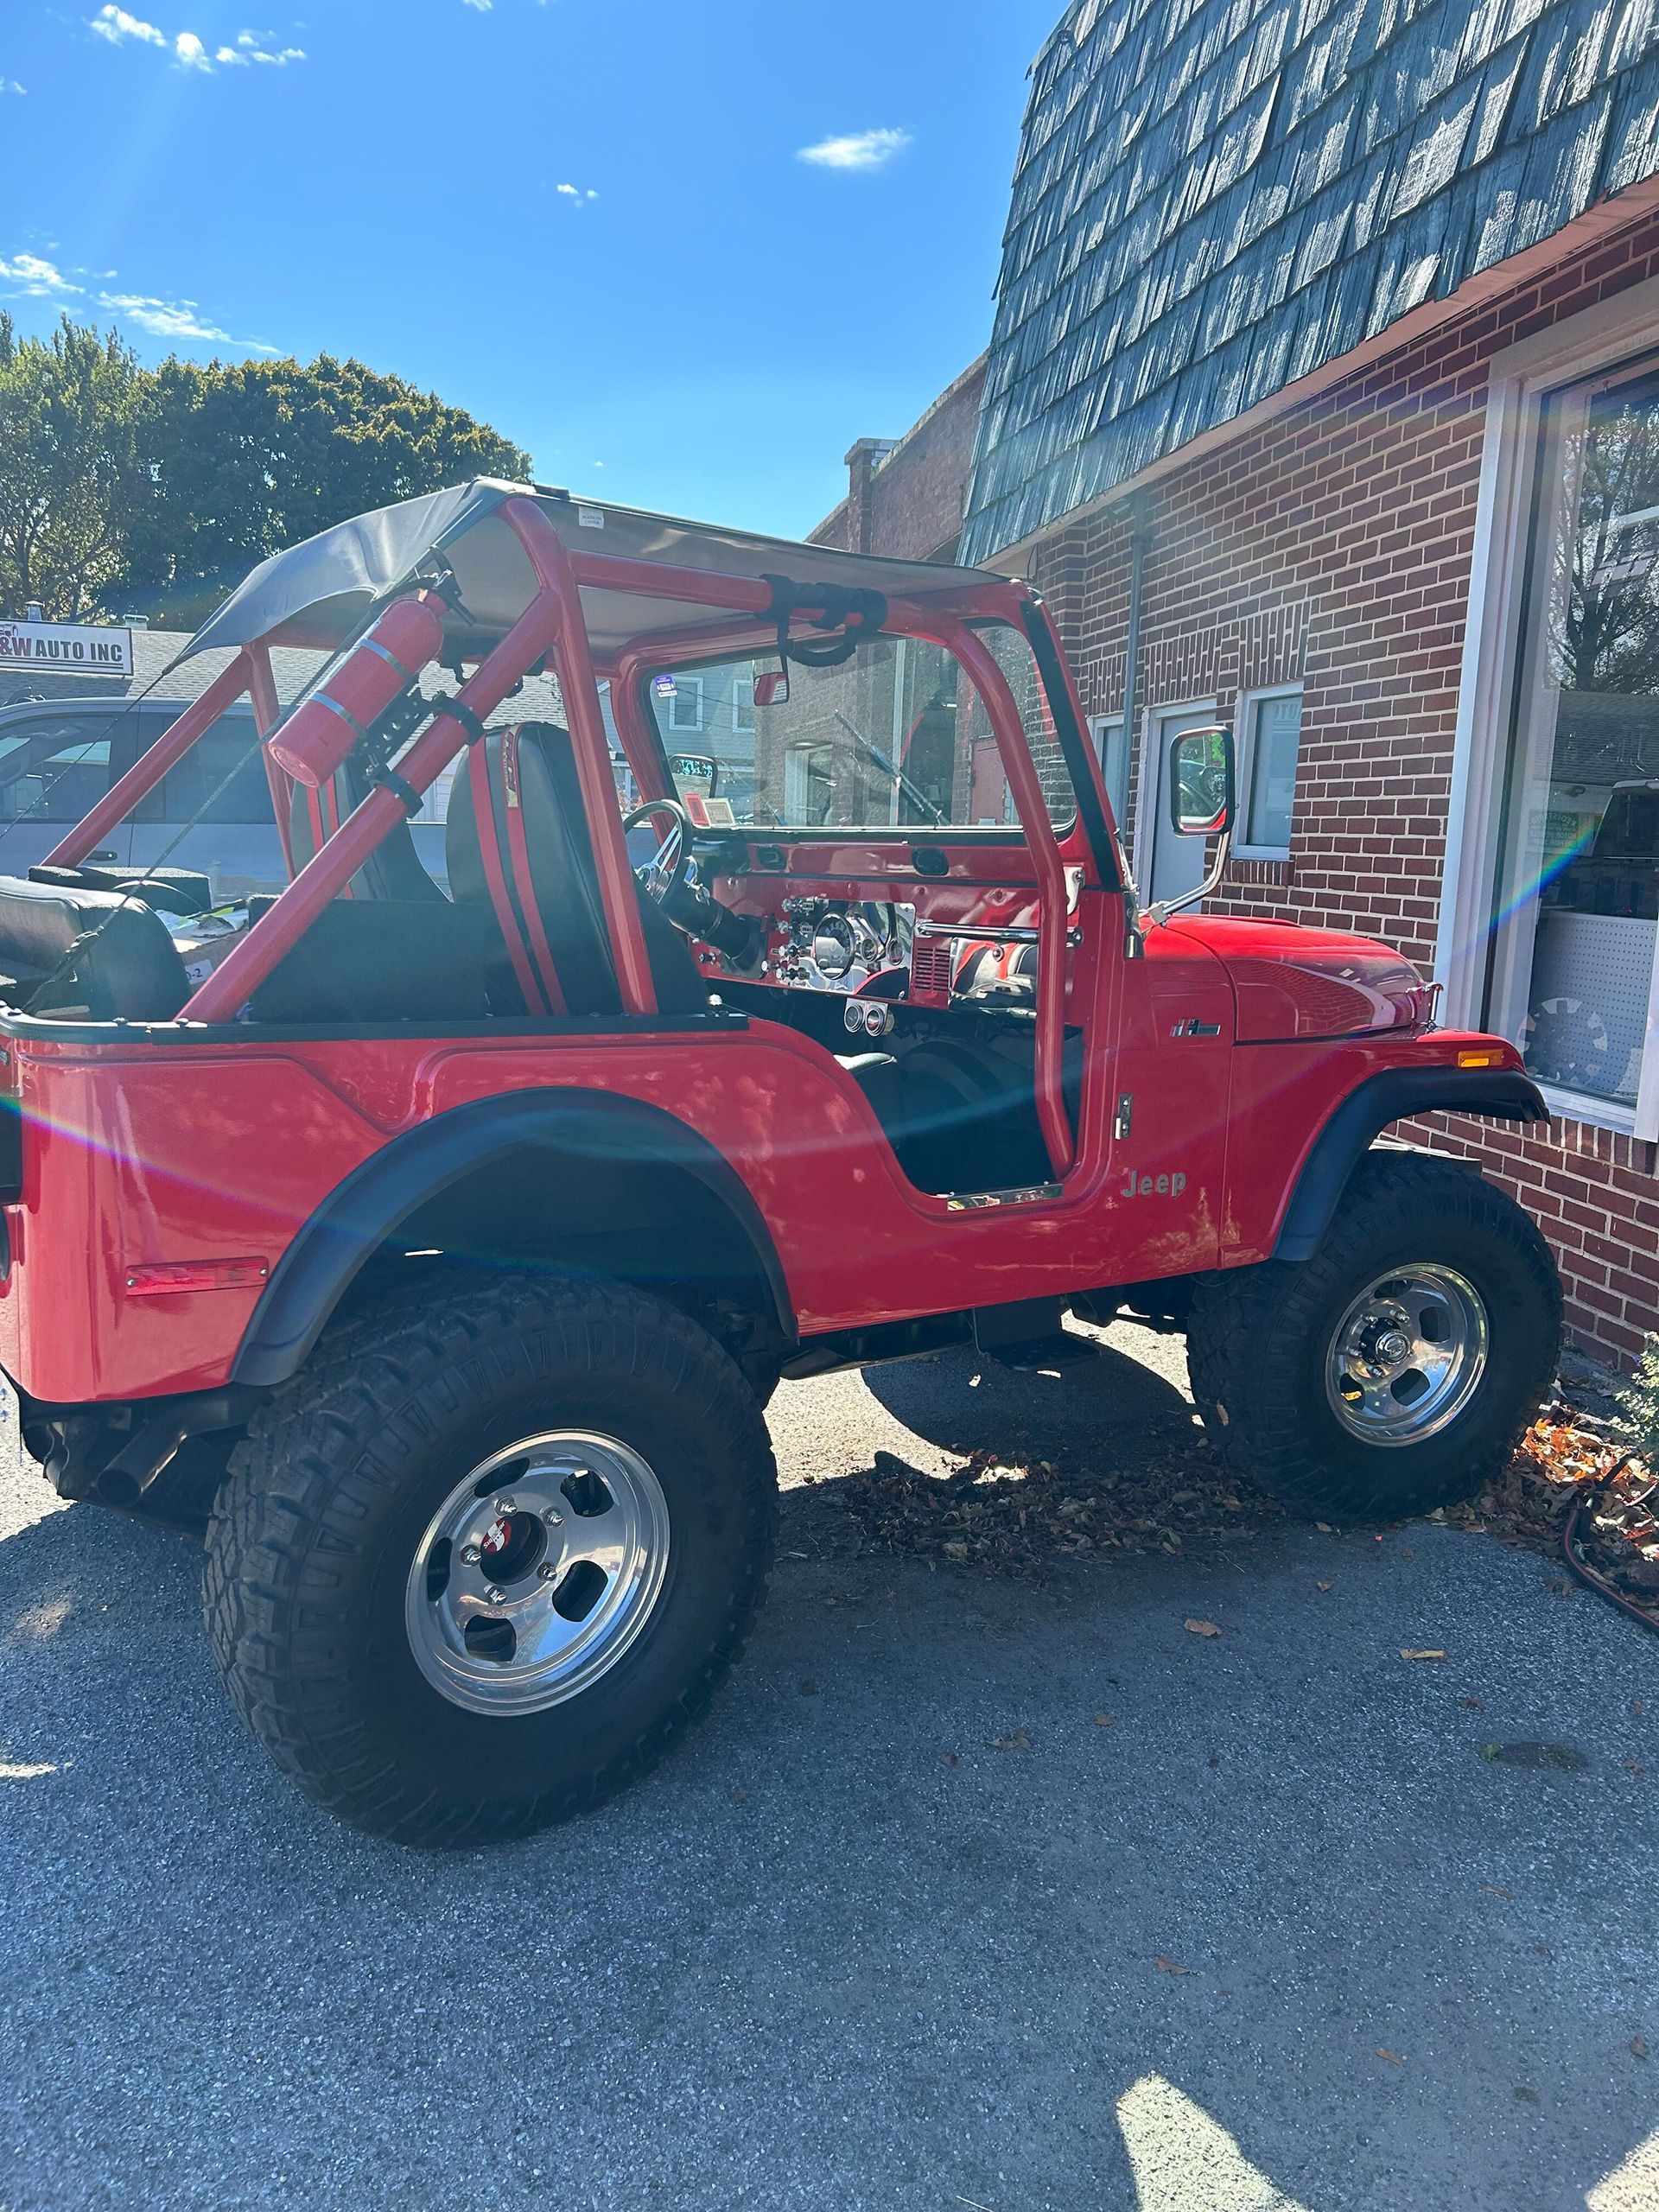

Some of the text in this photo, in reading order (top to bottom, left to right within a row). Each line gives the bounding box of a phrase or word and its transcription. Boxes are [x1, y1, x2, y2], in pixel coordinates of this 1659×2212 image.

[35, 639, 85, 660] AUTO
[90, 643, 124, 663] INC
[1121, 1169, 1187, 1198] Jeep
